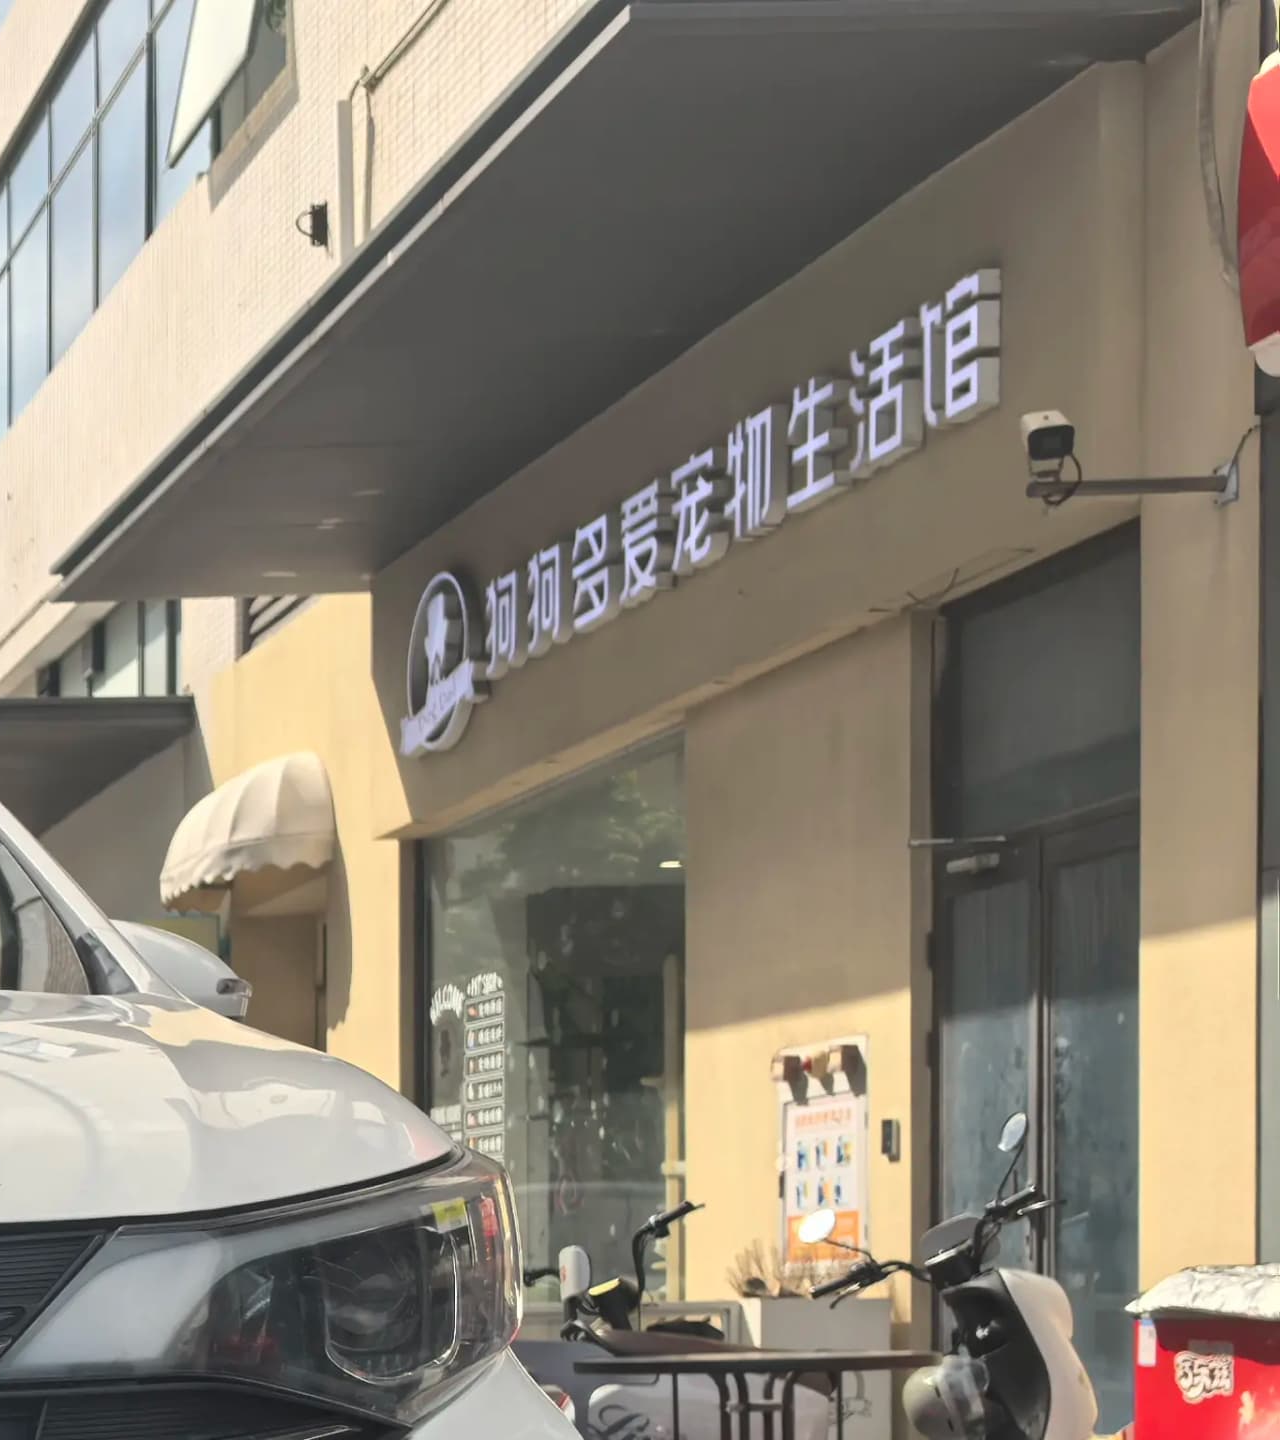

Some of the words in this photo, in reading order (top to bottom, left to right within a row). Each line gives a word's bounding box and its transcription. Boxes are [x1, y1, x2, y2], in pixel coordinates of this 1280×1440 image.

[484, 269, 990, 680] 狗狗多爱宠物生活馆
